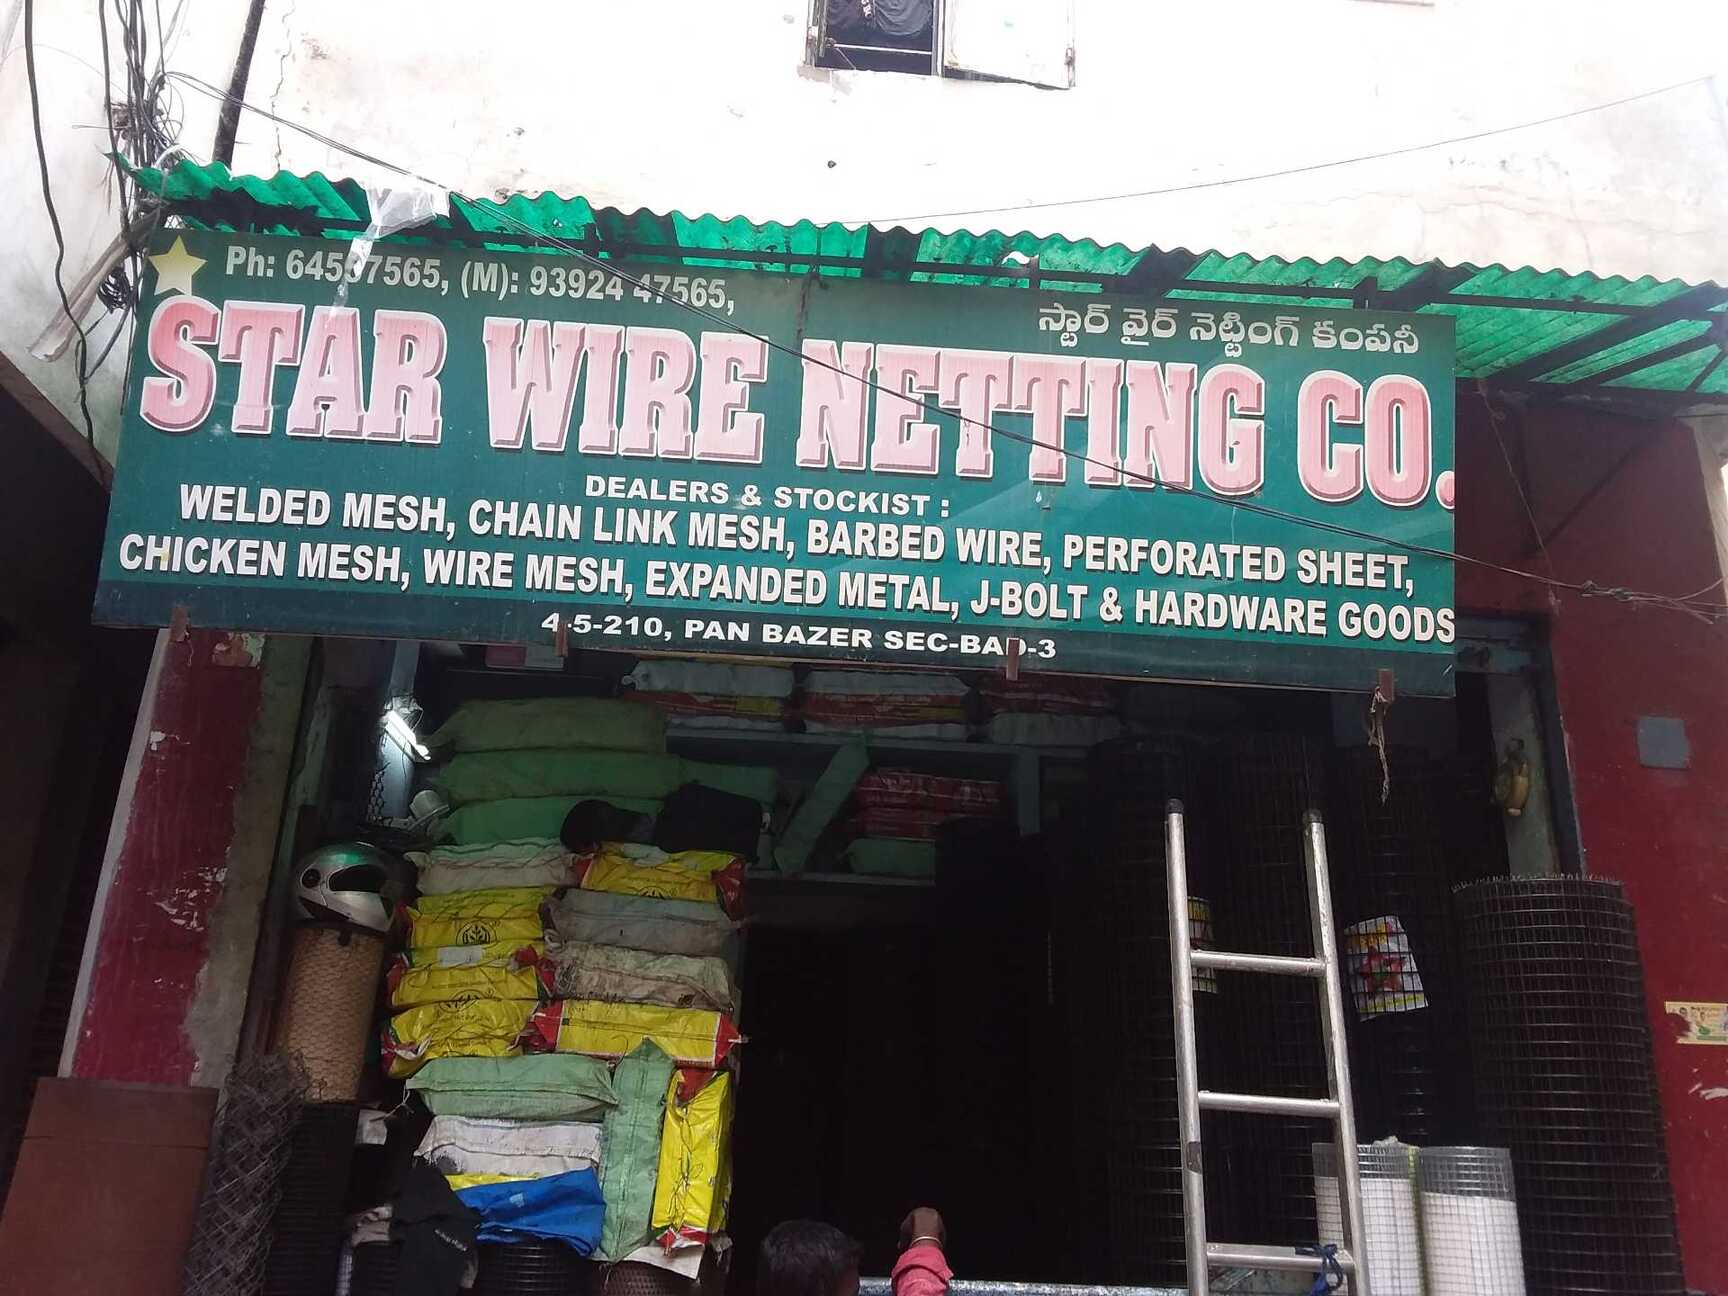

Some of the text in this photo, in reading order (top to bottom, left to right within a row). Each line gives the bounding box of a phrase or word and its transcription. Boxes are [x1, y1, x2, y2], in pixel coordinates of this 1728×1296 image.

[225, 245, 275, 278] Ph:
[461, 260, 519, 301] (M):
[529, 265, 625, 302] 93924
[140, 296, 1456, 510] STAR WIRE NETTING CO.
[585, 475, 729, 504] DEALERS
[741, 484, 762, 506] &
[773, 486, 931, 516] STOCKIST
[180, 483, 1414, 598] WELDED MESH, CHAIN LINK MESH, BARBED WIRE, PERFORATED SHEET,
[119, 533, 1455, 643] CHICKEN MESH, WIRE MESH, EXPANDED METAL, J-BOLT & HARDWARE GOODS
[684, 619, 750, 642] PAN
[762, 623, 873, 648] BAZER
